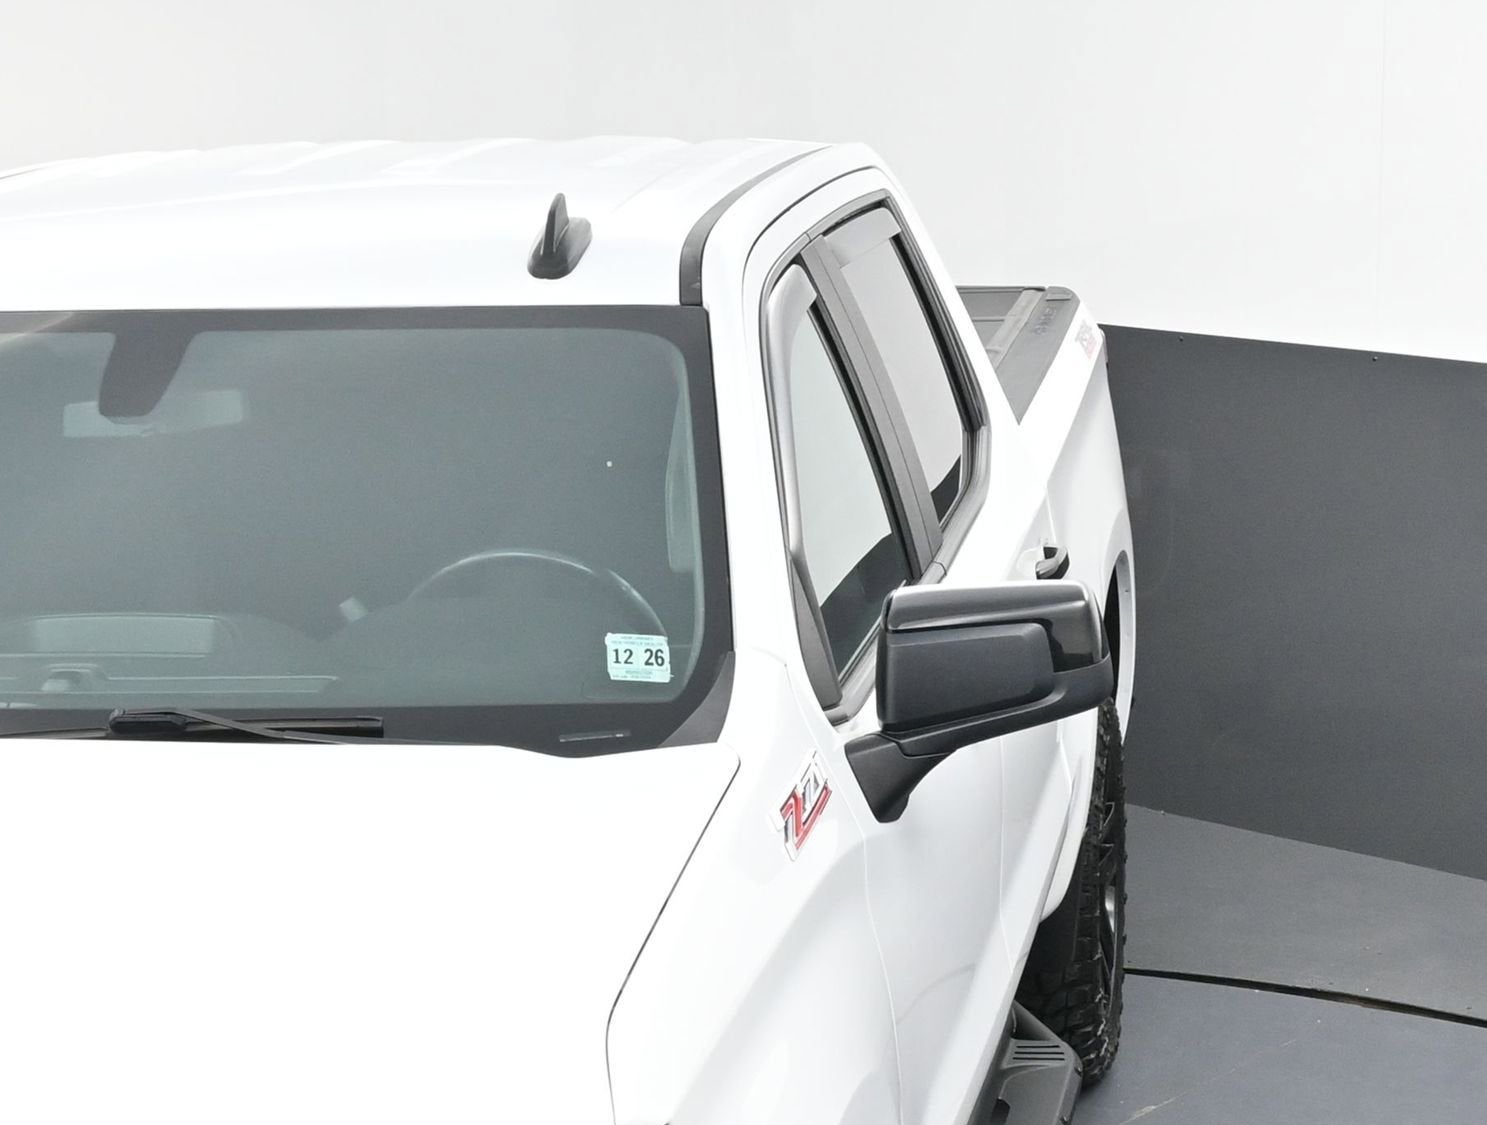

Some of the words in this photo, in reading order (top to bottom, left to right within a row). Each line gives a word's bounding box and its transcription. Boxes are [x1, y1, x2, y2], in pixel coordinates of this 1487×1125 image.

[612, 648, 634, 665] 12
[644, 648, 665, 667] 26
[770, 751, 833, 861] Z71
